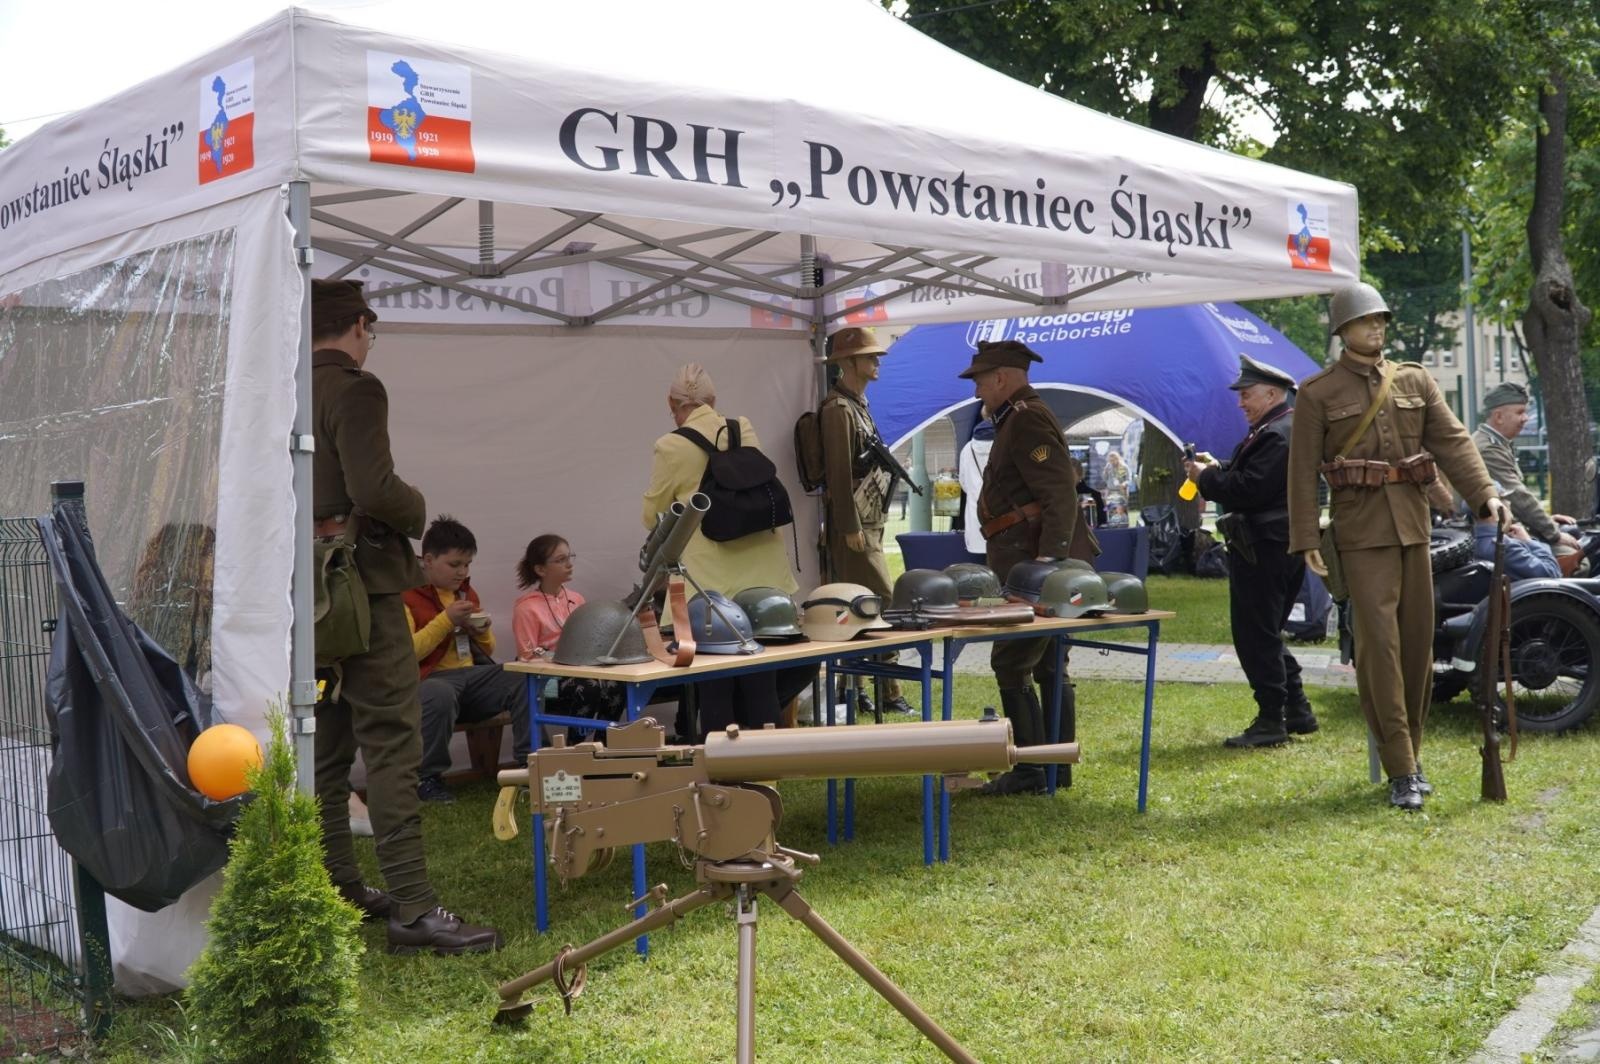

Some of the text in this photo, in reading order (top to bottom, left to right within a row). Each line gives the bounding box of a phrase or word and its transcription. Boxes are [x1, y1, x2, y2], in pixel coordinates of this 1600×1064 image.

[370, 130, 439, 143] 1919 1921
[558, 107, 749, 189] GRH
[417, 146, 440, 157] 1920
[0, 166, 91, 230] owstaniec
[1013, 320, 1132, 344] Raciborskie
